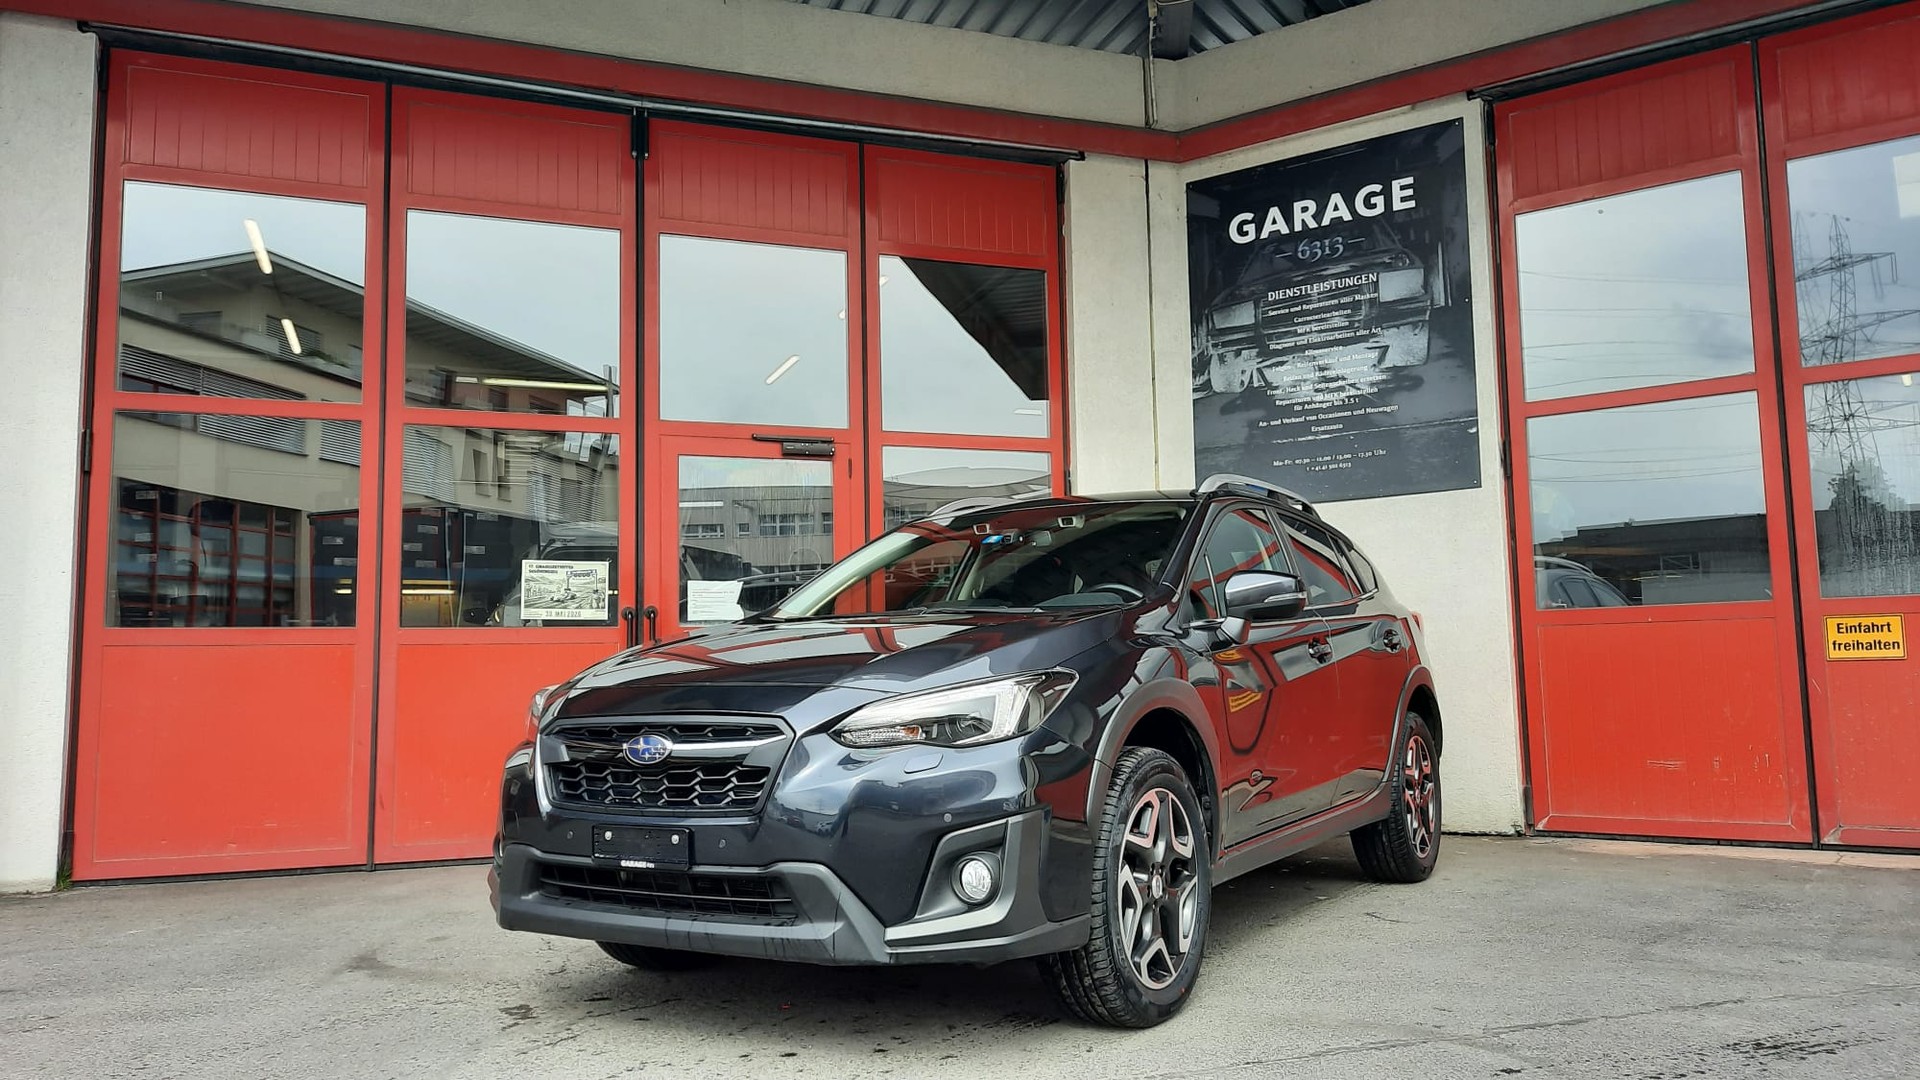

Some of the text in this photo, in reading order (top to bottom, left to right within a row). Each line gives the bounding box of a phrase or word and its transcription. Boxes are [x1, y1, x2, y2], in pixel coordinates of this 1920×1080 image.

[1228, 176, 1416, 244] GARAGE
[1296, 235, 1345, 263] 6313
[1267, 272, 1378, 301] DIENSTLEISTUNGEN
[1268, 308, 1290, 317] Service
[1290, 305, 1301, 313] und
[1302, 299, 1338, 311] Reparaturen
[1339, 296, 1353, 305] aller
[1269, 341, 1295, 350] Diagnose
[1308, 331, 1355, 344] Elektroarbeiten
[1355, 329, 1370, 337] aller
[1370, 325, 1383, 336] Art
[1286, 384, 1300, 393] Heck
[1301, 382, 1313, 391] und
[1360, 374, 1387, 383] ersetzen
[1275, 396, 1312, 406] Reparaturen
[1312, 393, 1324, 401] und
[1293, 403, 1303, 411] für
[1303, 400, 1333, 410] Anhänger
[1333, 397, 1343, 406] bis
[1270, 418, 1281, 426] und
[1282, 415, 1306, 424] Verkauf
[1317, 410, 1353, 420] Occasionen
[1353, 407, 1365, 416] und
[1365, 403, 1398, 414] Neuwagen
[1311, 423, 1344, 432] Ersatzauto
[1836, 621, 1892, 634] Einfahrt
[1832, 639, 1900, 651] freihalten
